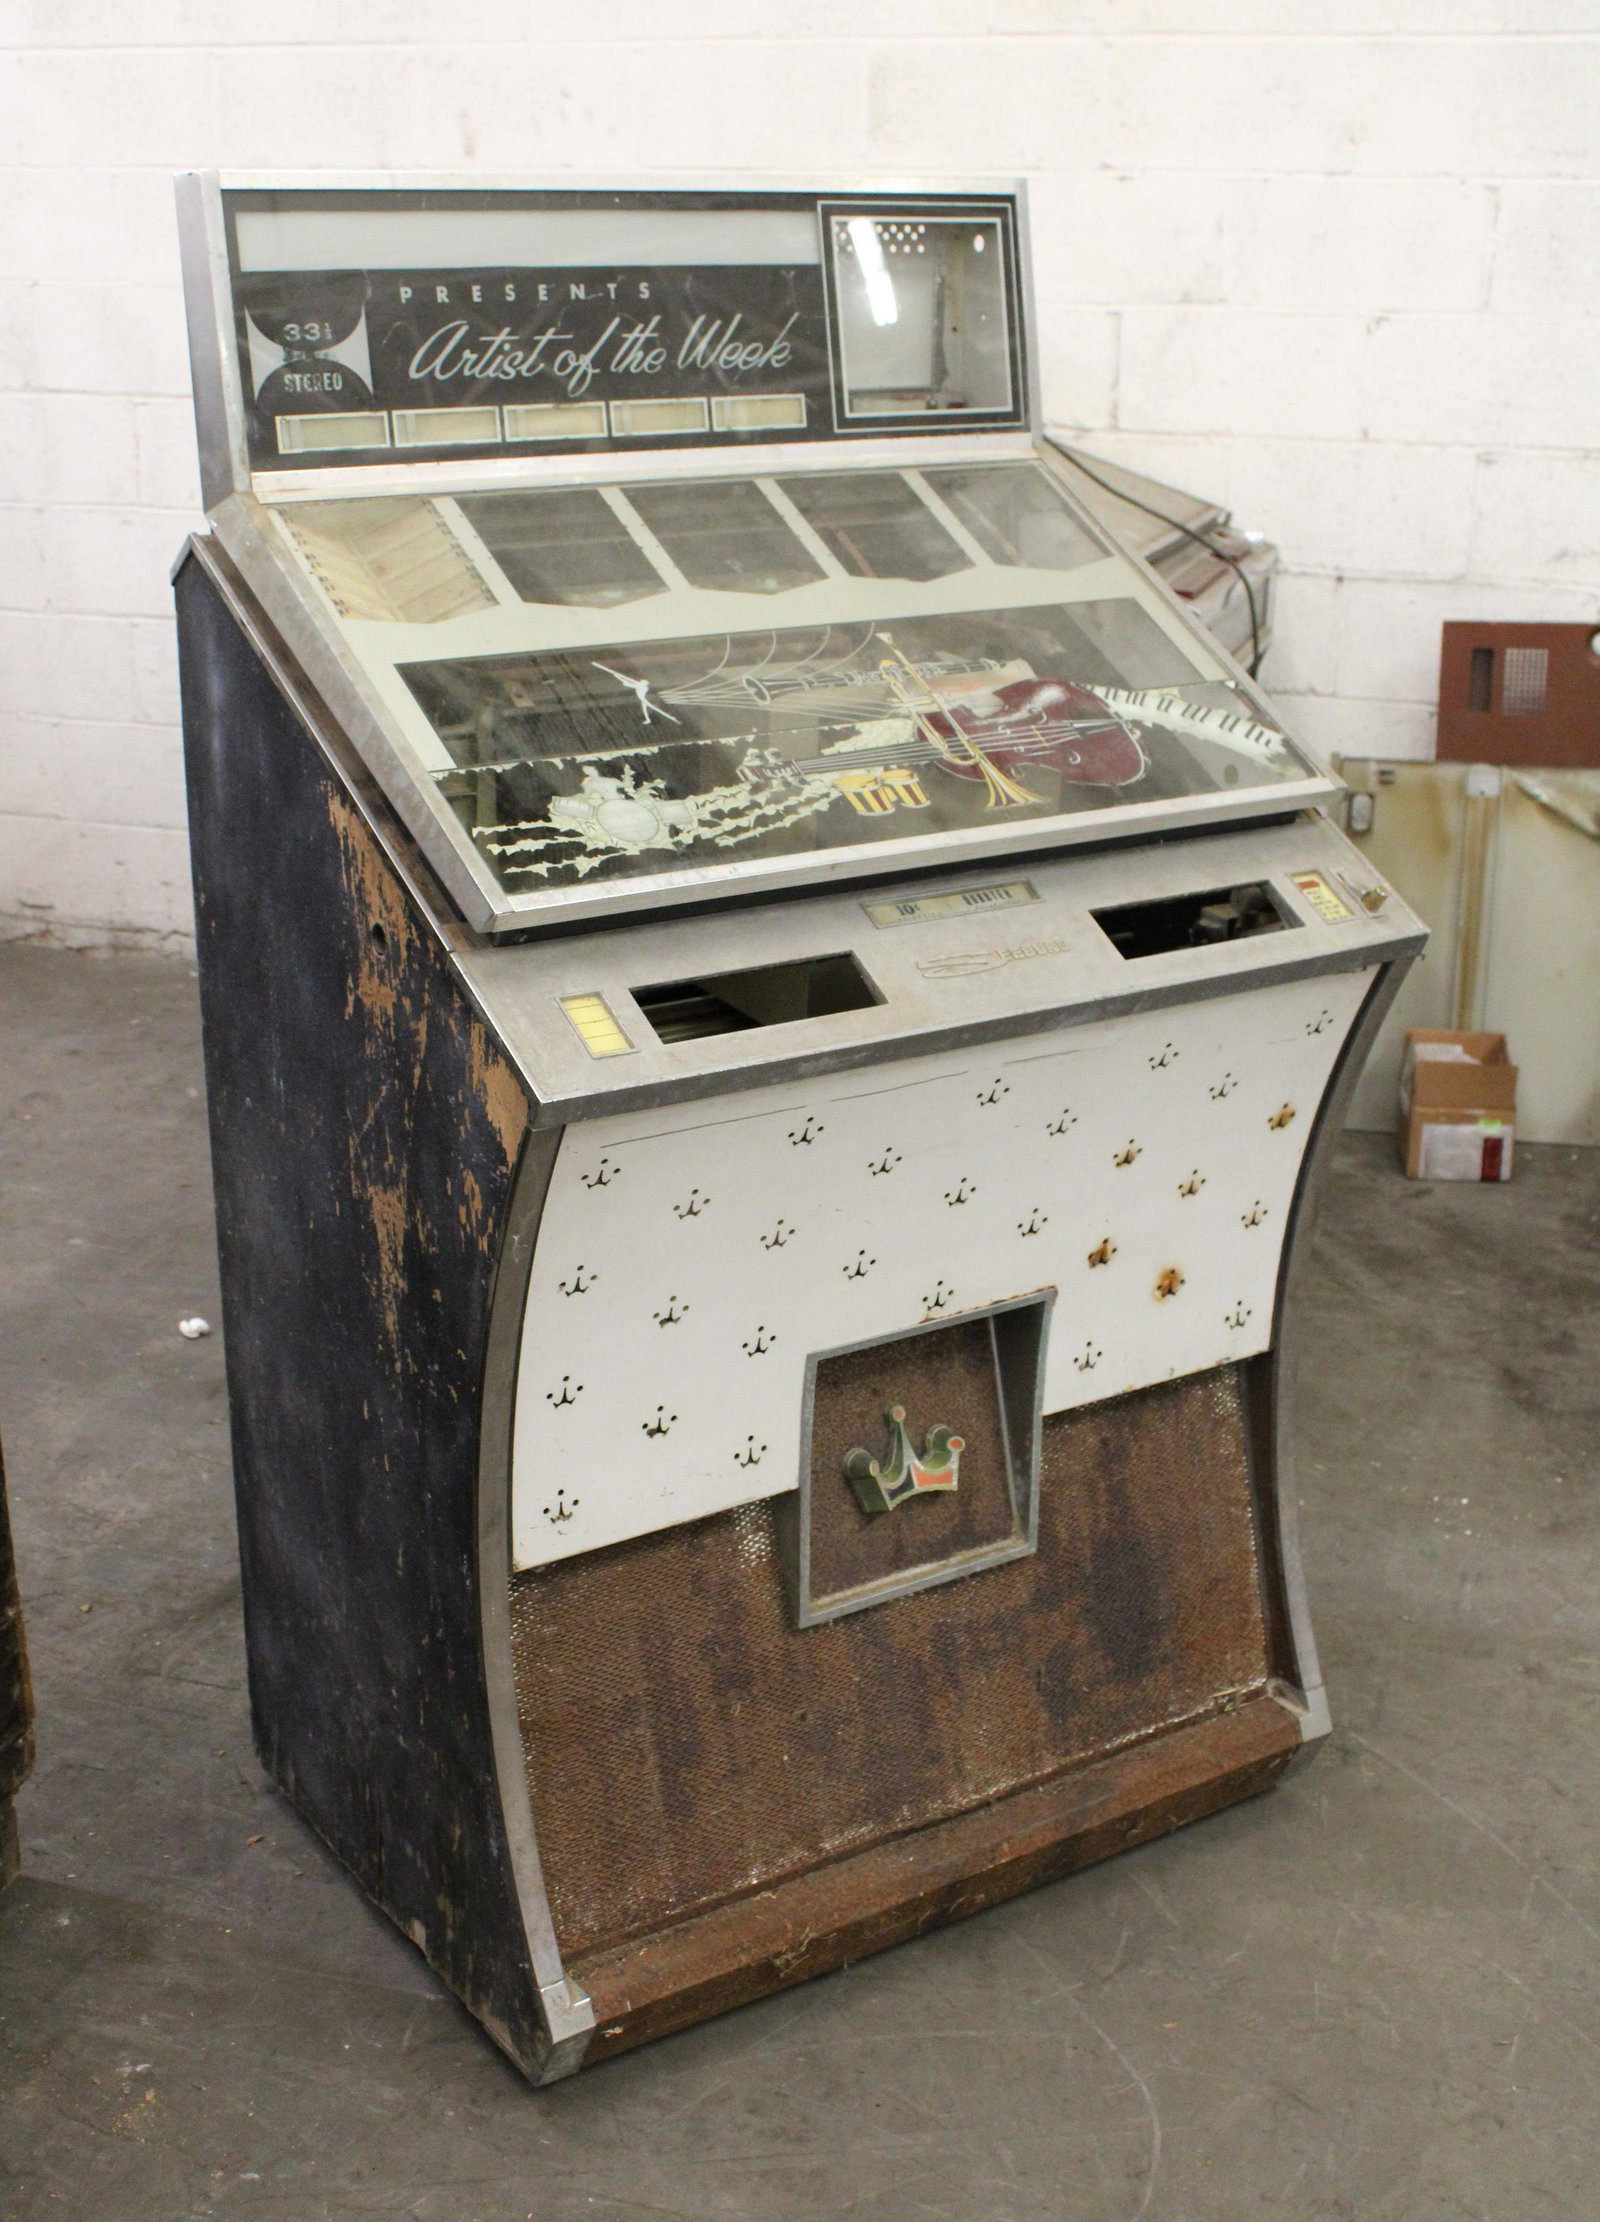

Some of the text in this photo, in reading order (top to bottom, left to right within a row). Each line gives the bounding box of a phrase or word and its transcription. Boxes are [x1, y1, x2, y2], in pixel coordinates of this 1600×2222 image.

[399, 282, 651, 304] PRESENTS
[408, 311, 800, 398] Artist of the Week
[284, 372, 343, 393] STEREO
